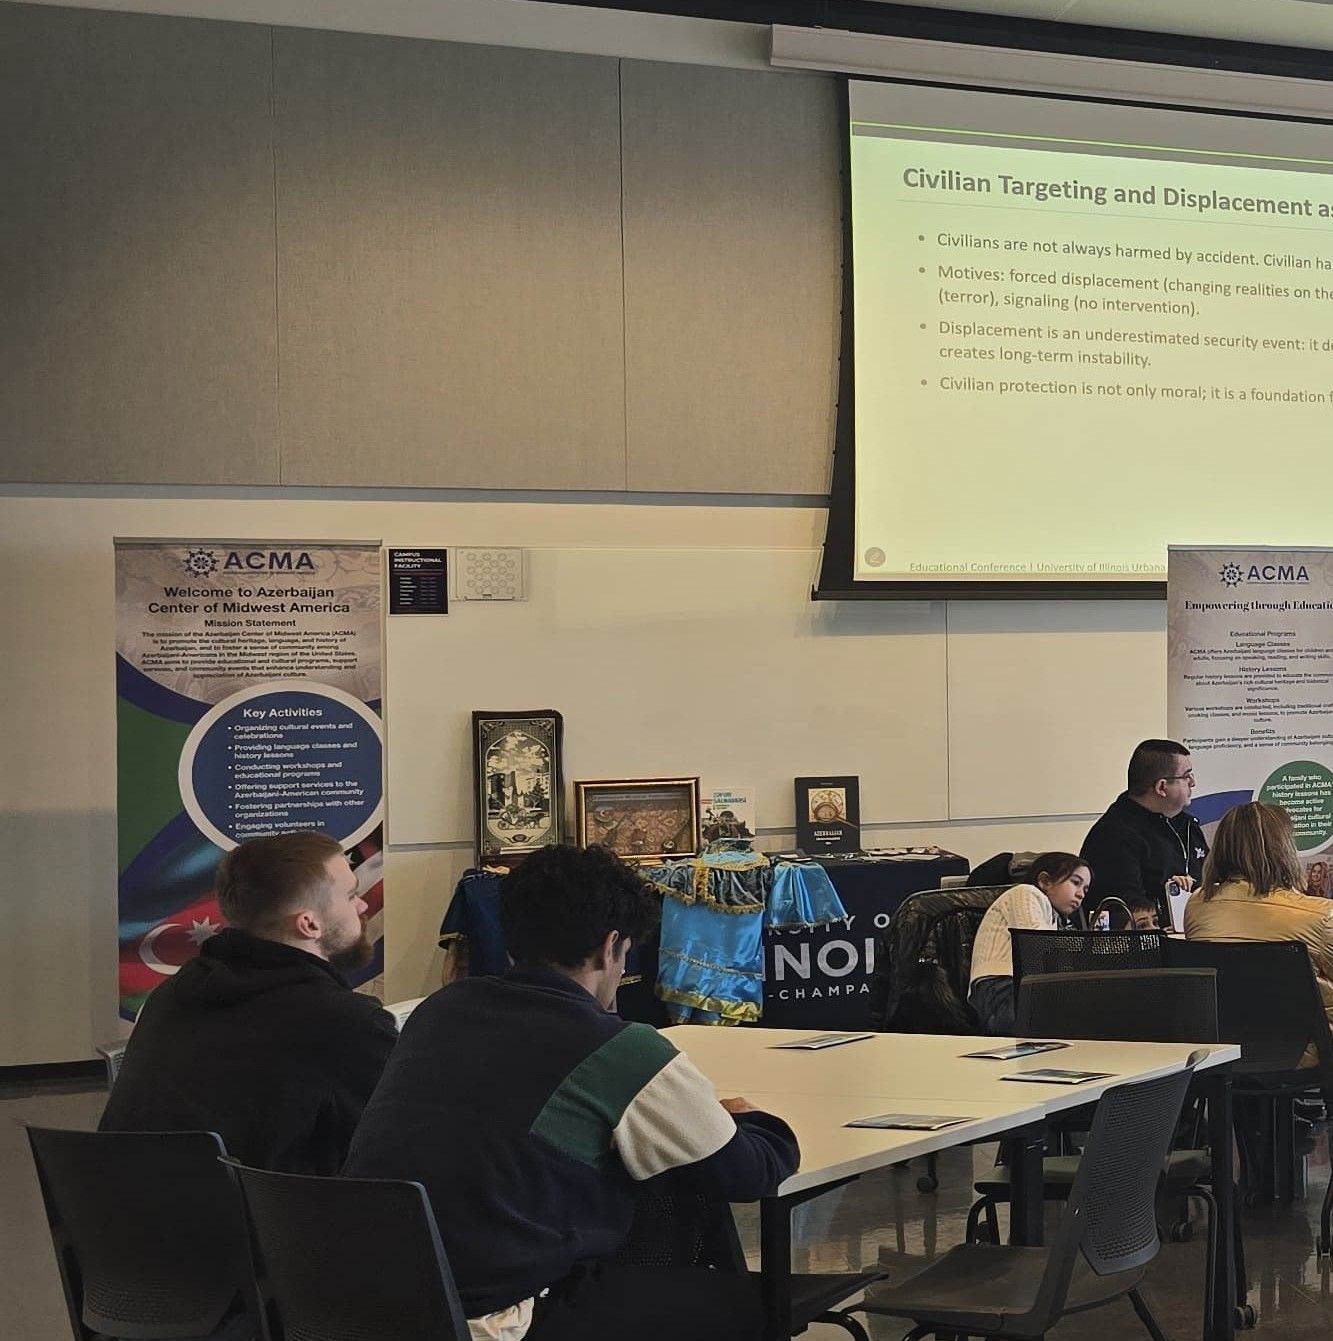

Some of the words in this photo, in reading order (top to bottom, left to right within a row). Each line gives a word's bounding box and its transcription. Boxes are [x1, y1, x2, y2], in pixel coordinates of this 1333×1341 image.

[903, 168, 991, 193] Civilian
[998, 175, 1107, 206] Targeting
[1114, 185, 1156, 205] and
[1164, 187, 1313, 216] Displacement
[937, 233, 1000, 249] Civilians
[1004, 240, 1028, 251] are
[1033, 241, 1058, 253] not
[1062, 240, 1111, 259] always
[1116, 243, 1171, 260] harmed
[1176, 247, 1193, 265] by
[1196, 250, 1259, 266] accident.
[1263, 254, 1311, 269] Civilian
[938, 265, 1005, 281] Motives:
[1009, 268, 1056, 284] forced
[1061, 272, 1159, 291] displacement
[1163, 277, 1231, 297] (changing
[1235, 283, 1290, 298] realities
[1294, 288, 1311, 299] on
[939, 287, 999, 307] (terror),
[1004, 292, 1070, 311] signaling
[1074, 294, 1098, 312] (no
[1102, 298, 1200, 318] intervention).
[939, 321, 1043, 339] Displacement
[1047, 325, 1059, 339] is
[1062, 329, 1080, 340] an
[1085, 328, 1200, 345] underestimated
[1204, 334, 1258, 351] security
[1262, 339, 1305, 351] event:
[1309, 338, 1319, 351] it
[939, 347, 995, 360] creates
[1000, 346, 1073, 364] long-term
[1078, 350, 1151, 369] instability.
[940, 376, 994, 391] Civilian
[999, 381, 1077, 395] protection
[1082, 381, 1095, 397] is
[1097, 384, 1122, 396] not
[1126, 383, 1157, 400] only
[1161, 385, 1207, 401] moral;
[1211, 386, 1221, 400] it
[1224, 387, 1234, 400] is
[1238, 390, 1246, 400] a
[1250, 387, 1325, 403] foundation
[224, 552, 314, 570] ACMA
[1247, 565, 1309, 581] ACMA
[164, 586, 233, 598] Welcome
[237, 587, 252, 597] to
[256, 587, 334, 599] Azerbaijan
[148, 601, 199, 614] Center
[203, 602, 219, 613] of
[222, 602, 286, 613] Midwest
[289, 600, 350, 613] America
[1185, 600, 1250, 612] Empowering
[1251, 600, 1291, 612] through
[204, 619, 243, 627] Mission
[245, 619, 296, 627] Statement
[1267, 630, 1296, 639] Programs
[243, 709, 266, 719] Key
[268, 707, 322, 718] Activities
[234, 724, 278, 733] Organizing
[233, 732, 284, 740] celebrations
[234, 744, 272, 752] Providing
[273, 743, 310, 751] language
[234, 752, 262, 760] history
[282, 762, 326, 770] workshops
[234, 771, 282, 779] educational
[268, 782, 300, 792] support
[234, 790, 319, 799] Azerbaijani-American
[321, 788, 364, 796] community
[274, 801, 324, 810] partnerships
[235, 811, 289, 819] organizations
[235, 822, 273, 830] Engaging
